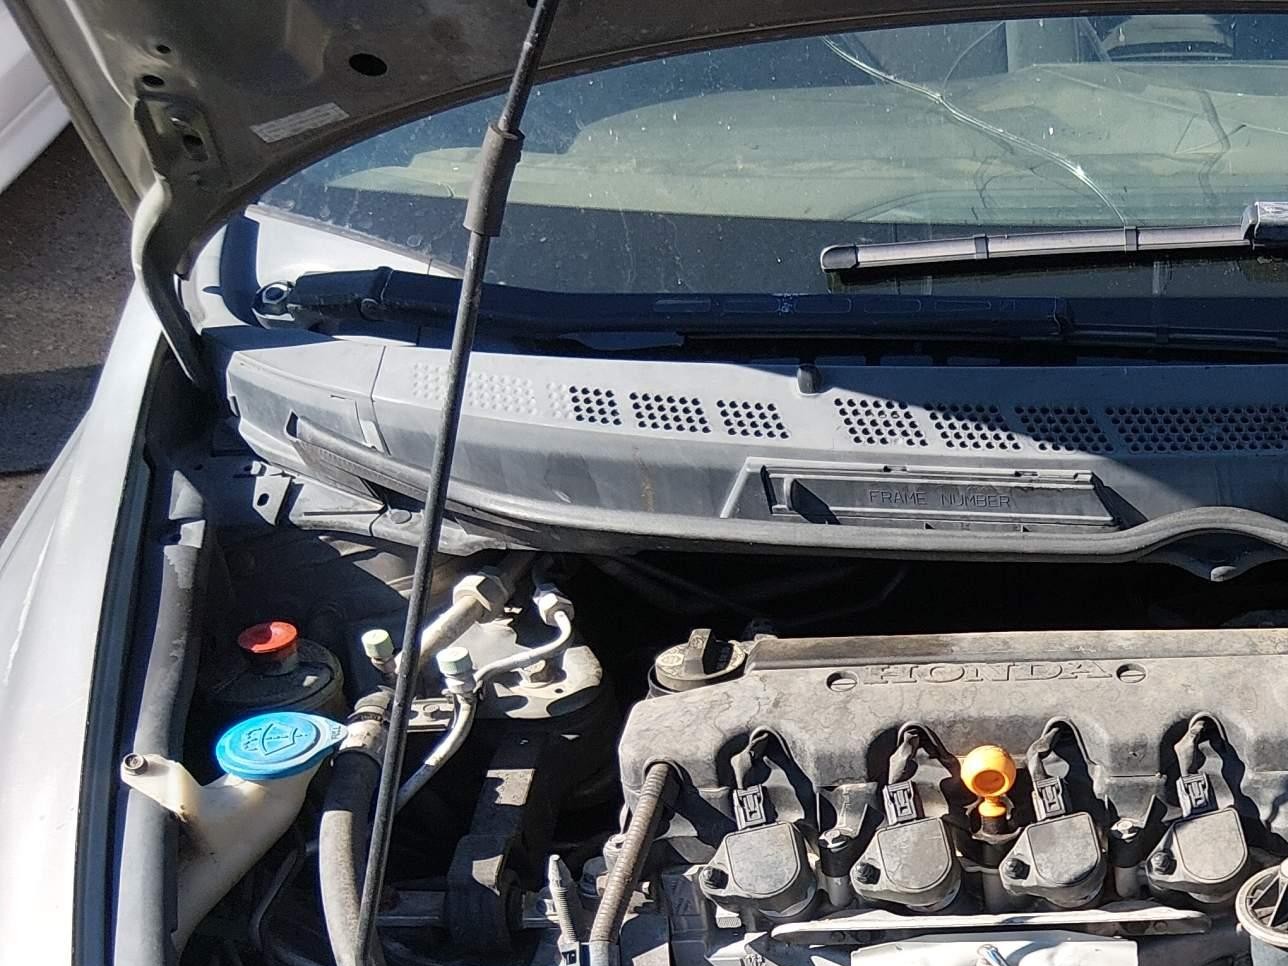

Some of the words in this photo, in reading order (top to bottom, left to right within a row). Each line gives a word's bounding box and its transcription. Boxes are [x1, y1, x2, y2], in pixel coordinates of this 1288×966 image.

[869, 490, 928, 506] FRAME
[940, 493, 1011, 508] NUMBER
[863, 662, 1113, 685] HONDA
